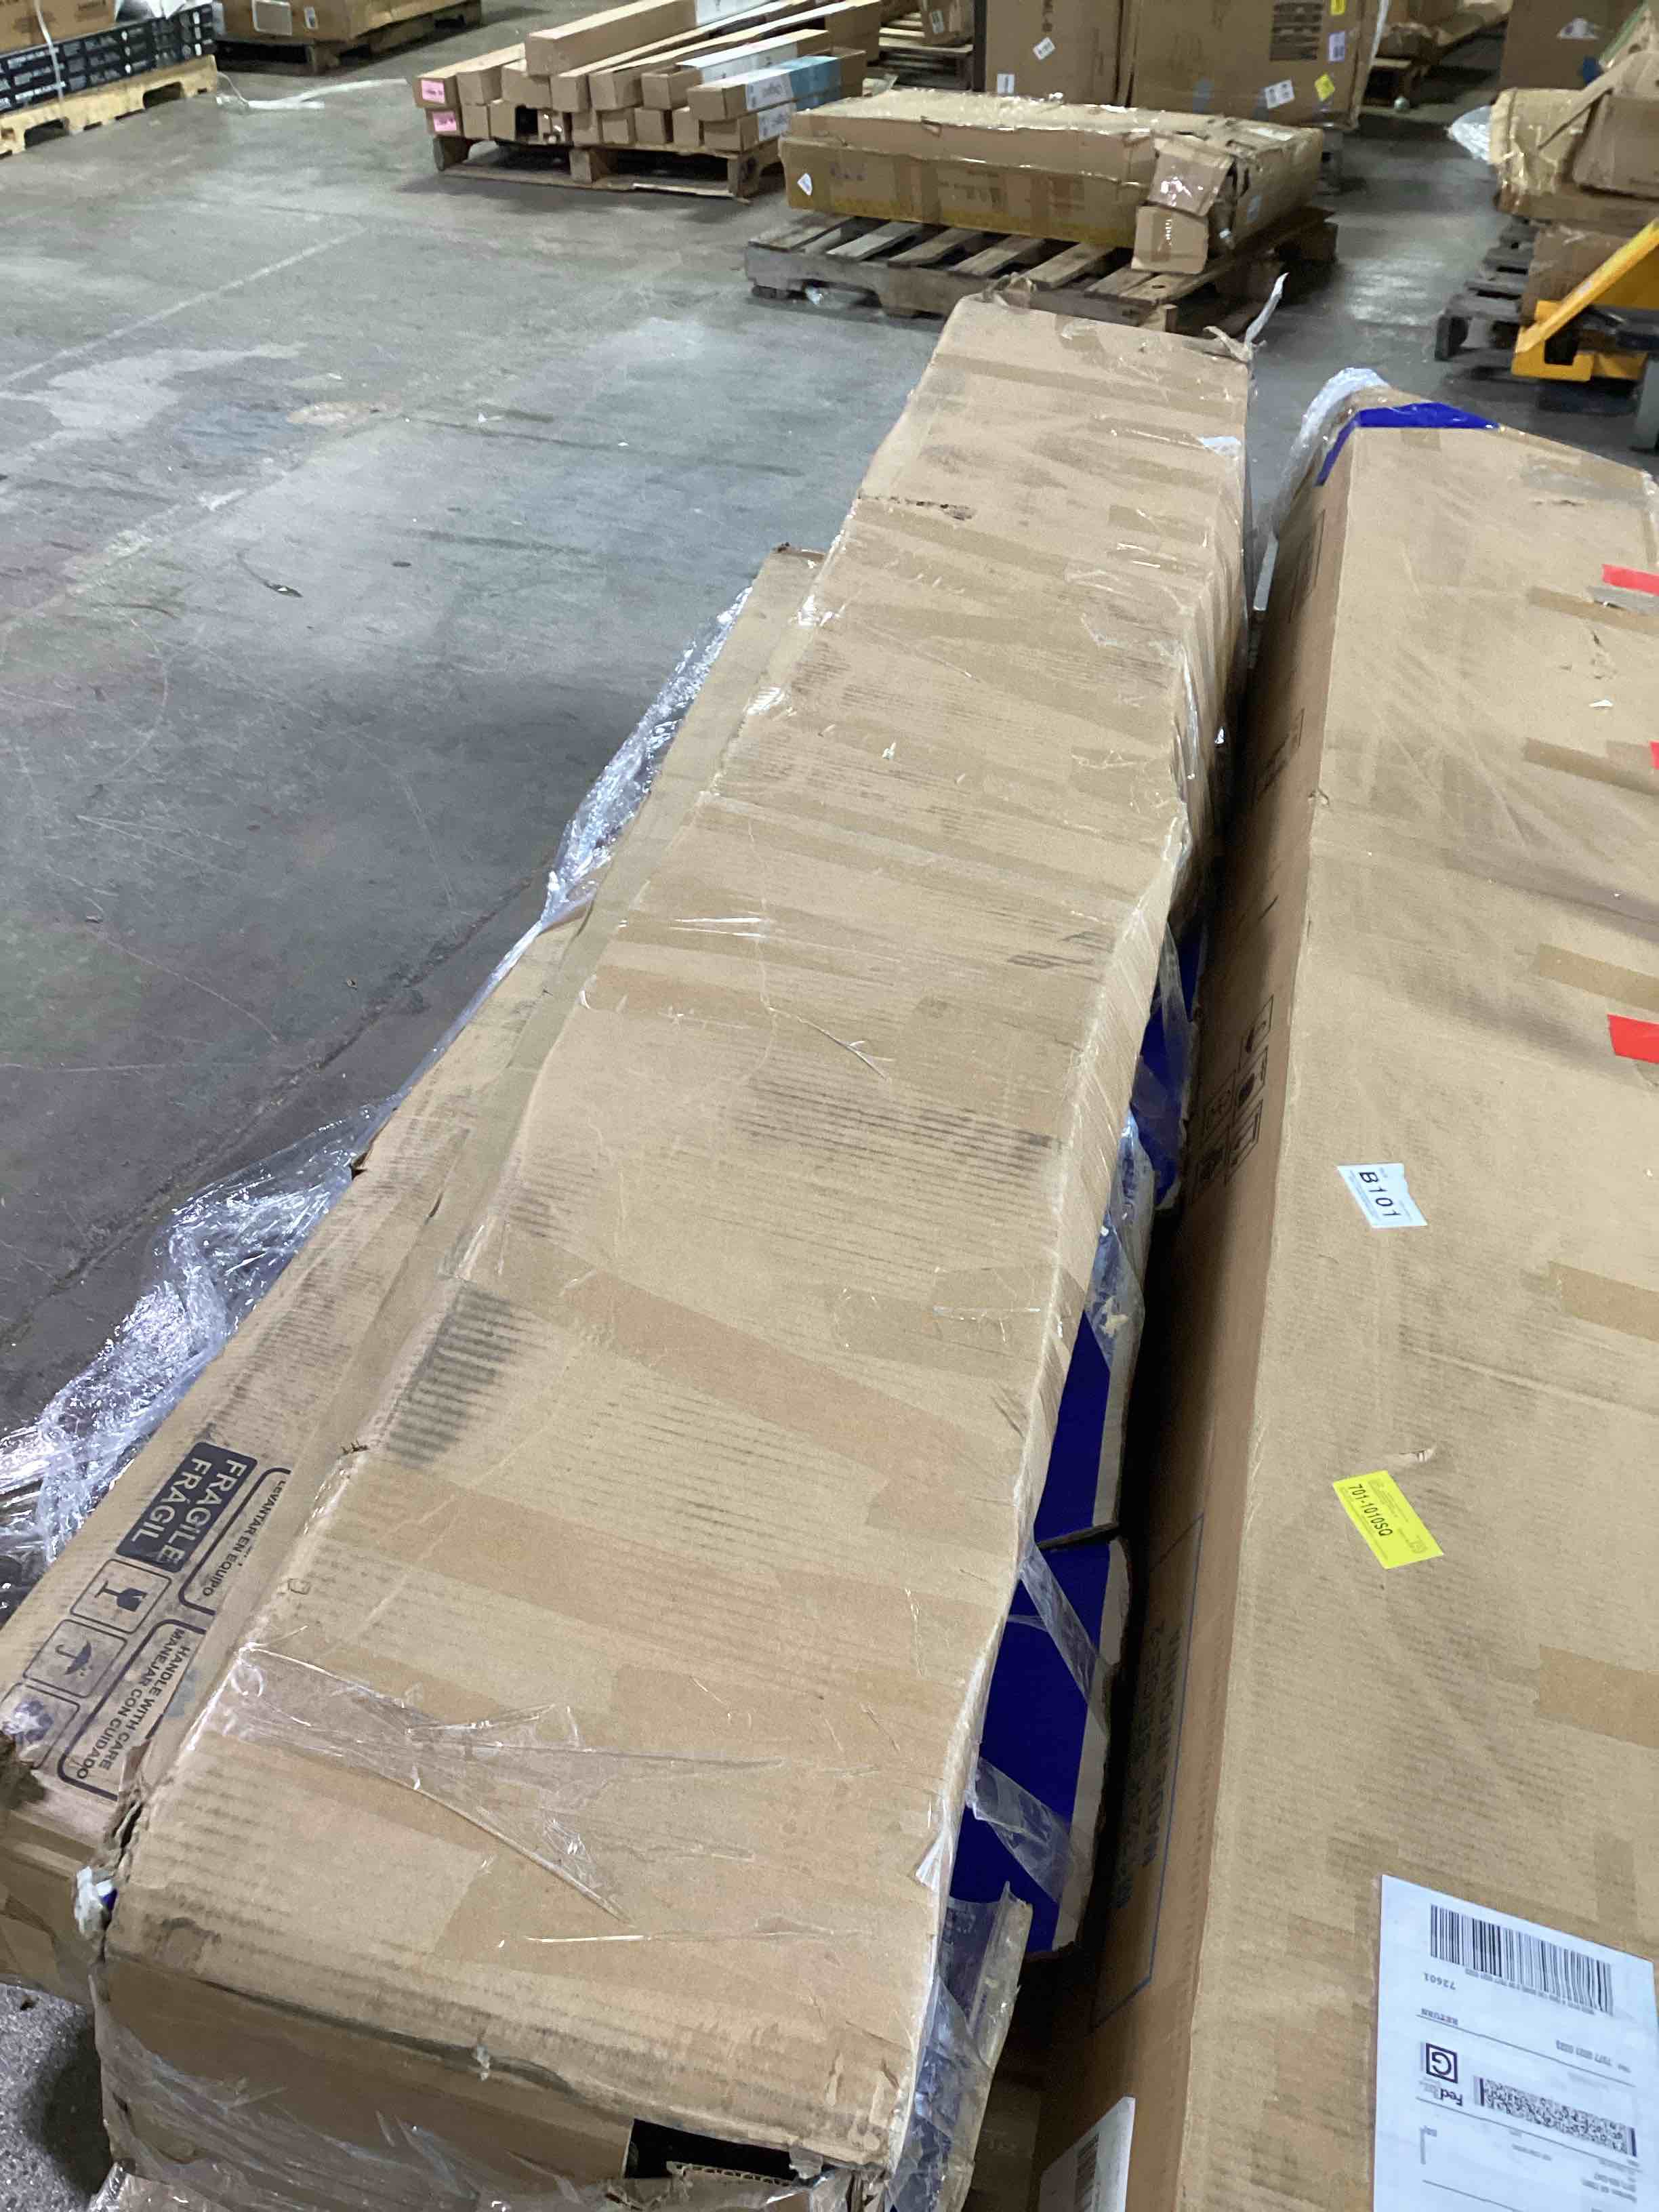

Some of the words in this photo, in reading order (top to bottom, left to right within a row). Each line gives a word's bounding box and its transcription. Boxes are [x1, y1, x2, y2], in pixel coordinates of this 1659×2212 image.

[1359, 1172, 1401, 1216] B101
[157, 1458, 248, 1564] FRAGILE
[243, 1480, 287, 1535] LEVANTAR
[1348, 1483, 1393, 1536] 701-1010SQ
[232, 1536, 250, 1553] EN
[202, 1553, 237, 1597] EQUIPO
[138, 1628, 185, 1686] MANEJAR
[149, 1645, 190, 1696] HANDLE
[117, 1688, 142, 1717] CON
[128, 1699, 155, 1731] WITH
[77, 1717, 122, 1779] CUIDADO
[98, 1732, 131, 1771] CARE
[1431, 2051, 1452, 2076] G
